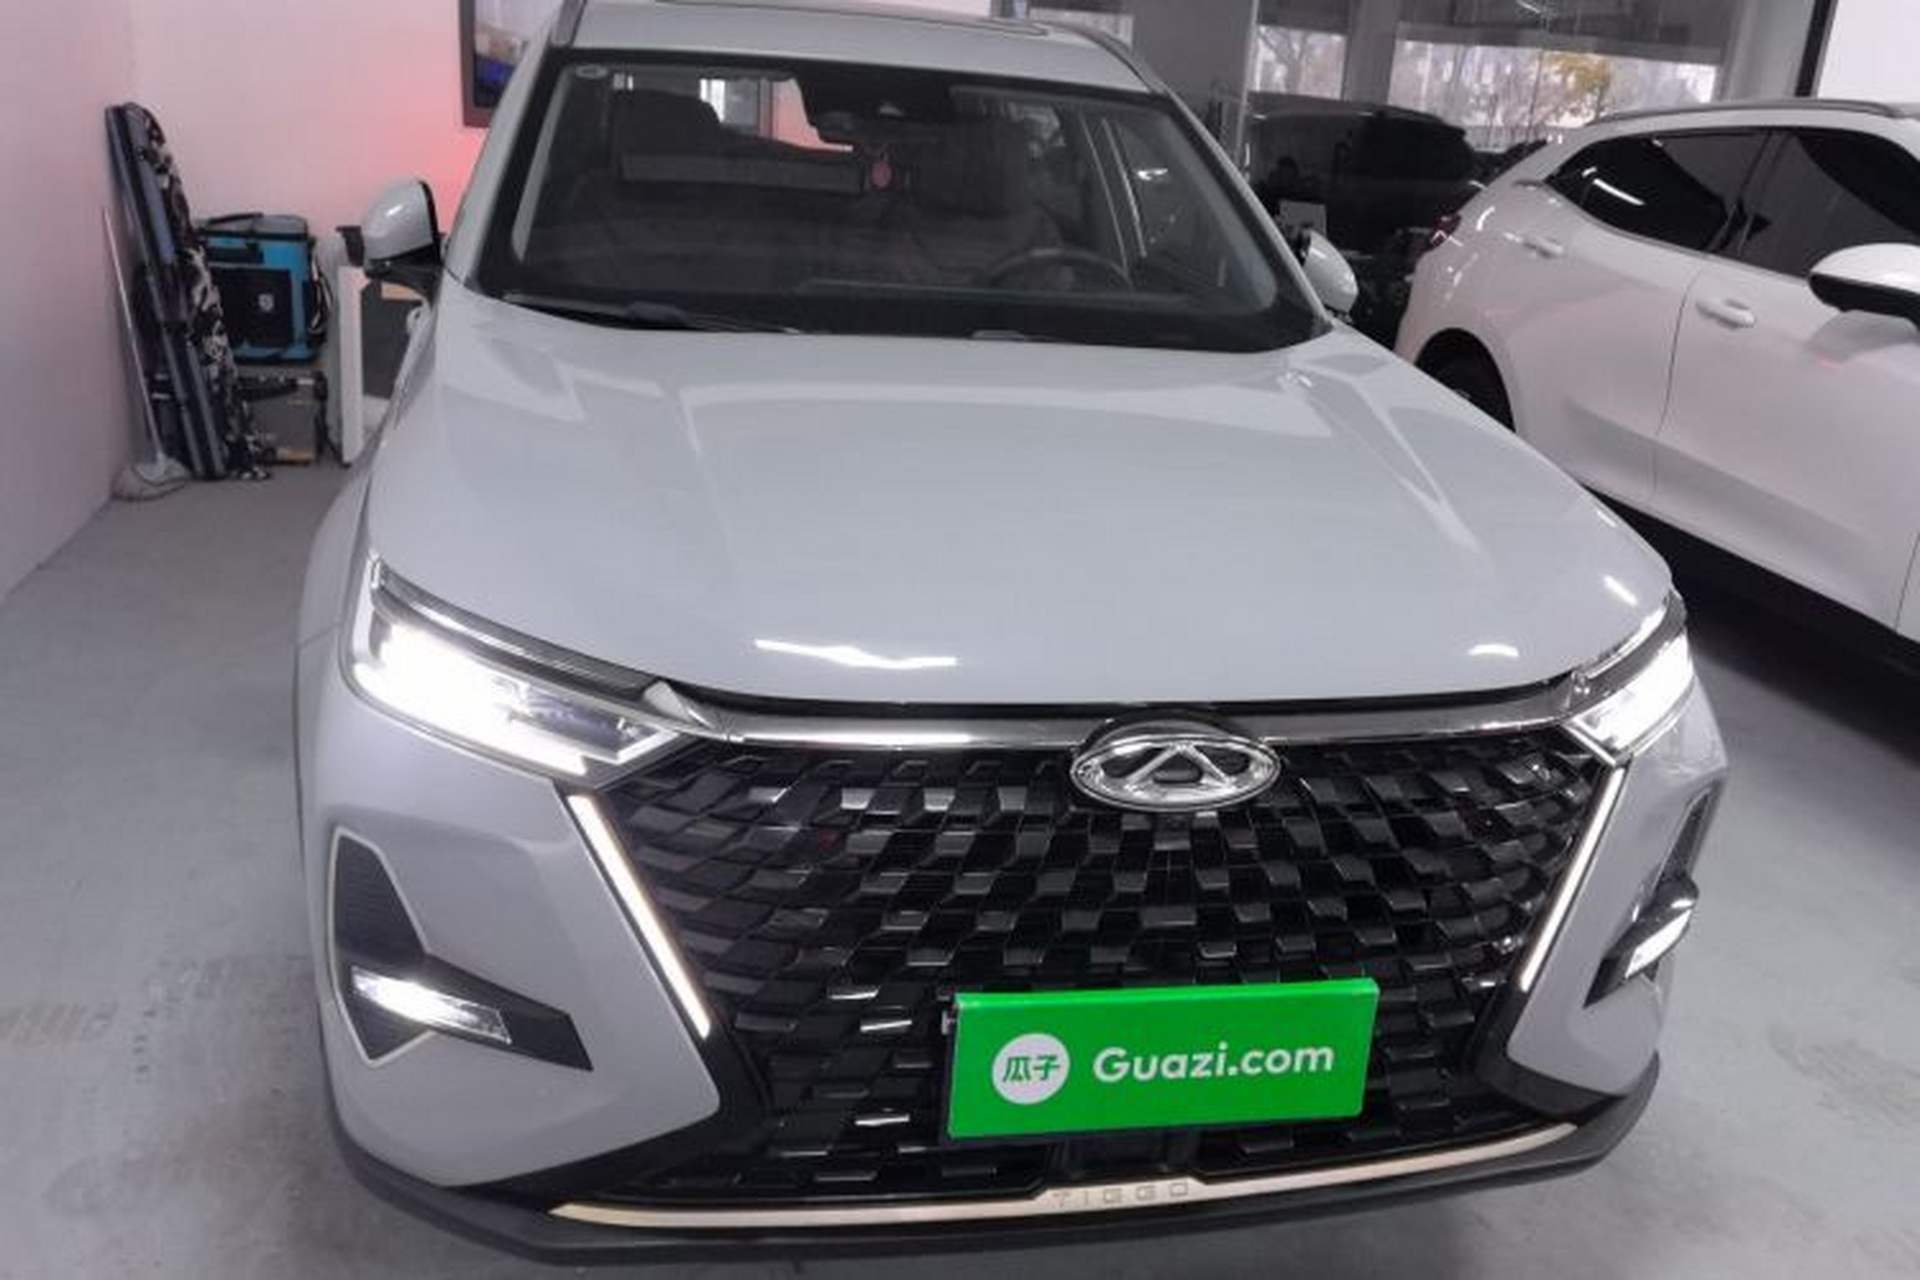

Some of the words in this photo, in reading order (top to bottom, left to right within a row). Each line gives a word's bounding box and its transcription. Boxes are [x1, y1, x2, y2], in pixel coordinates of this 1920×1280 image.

[1003, 1055, 1062, 1083] 瓜子
[1094, 1043, 1335, 1082] Guazi.com
[1053, 1182, 1190, 1207] TIGGO
